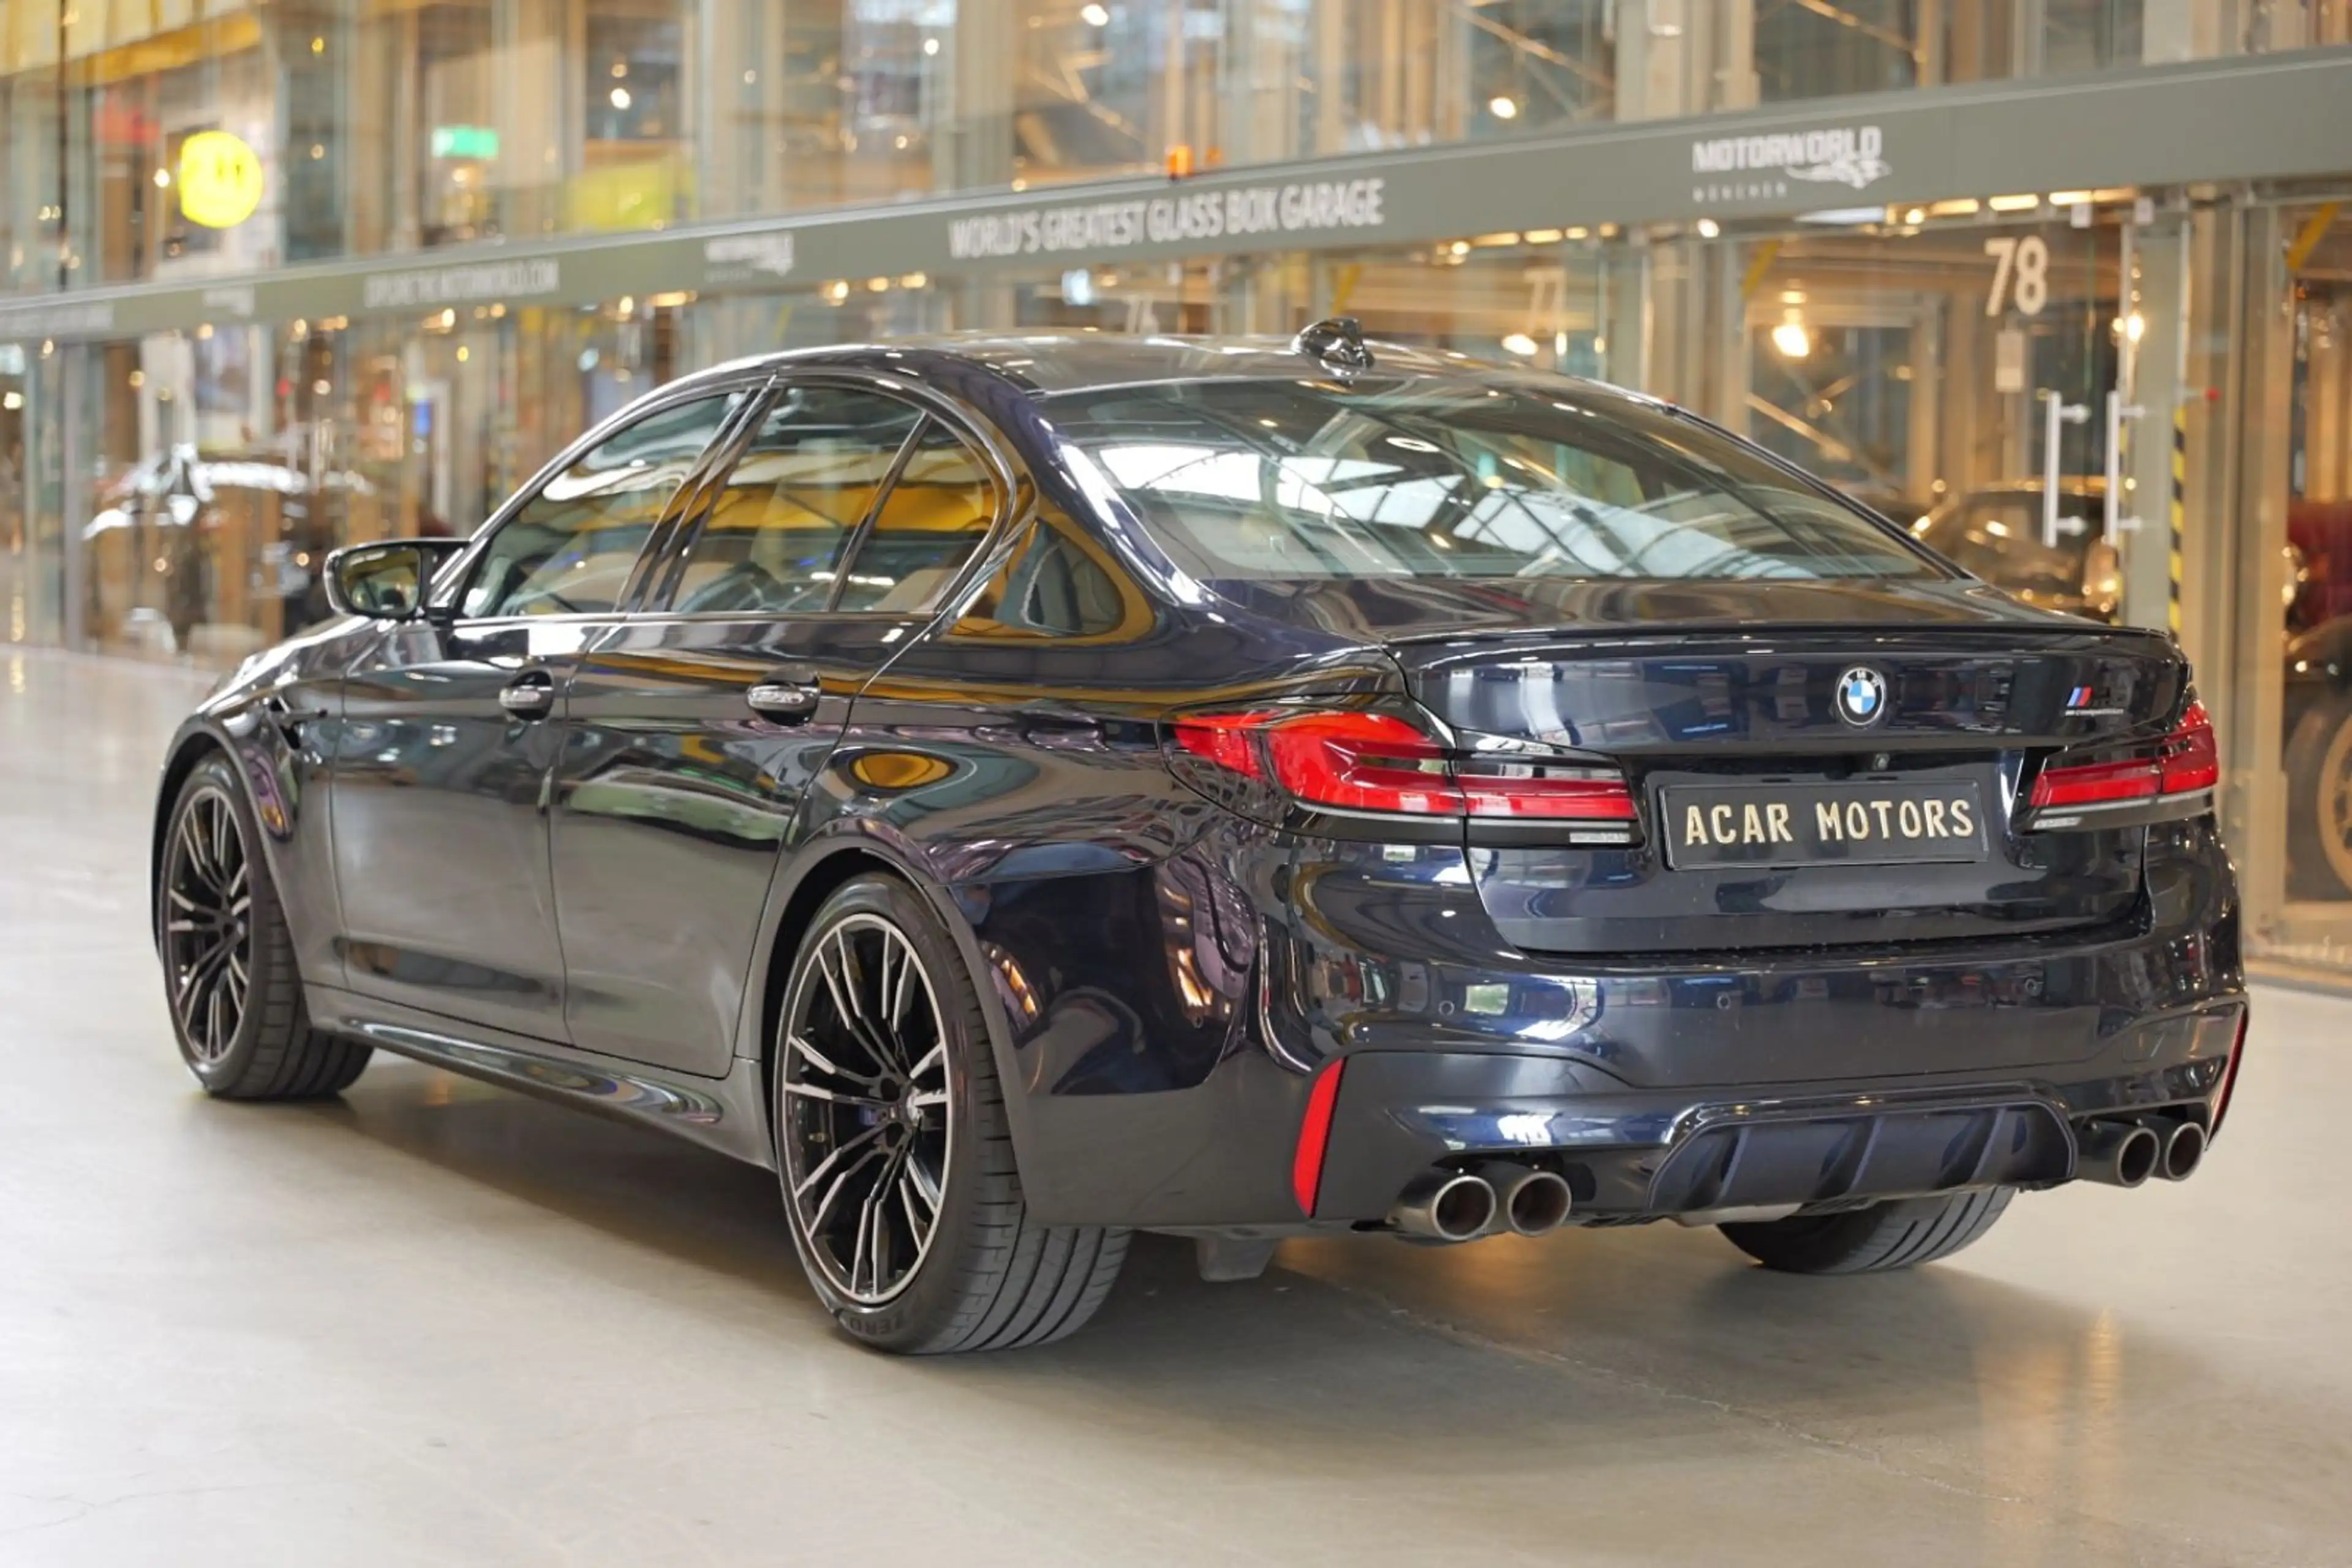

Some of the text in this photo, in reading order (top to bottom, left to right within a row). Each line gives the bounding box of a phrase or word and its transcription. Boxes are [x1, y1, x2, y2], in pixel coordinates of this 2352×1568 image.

[1692, 126, 1882, 173] MOTORWORLD
[950, 178, 1385, 259] WORLD'S GREATEST GLASS BOX GARAGE
[1984, 235, 2048, 316] 78
[1684, 799, 1974, 846] ACAR MOTORS
